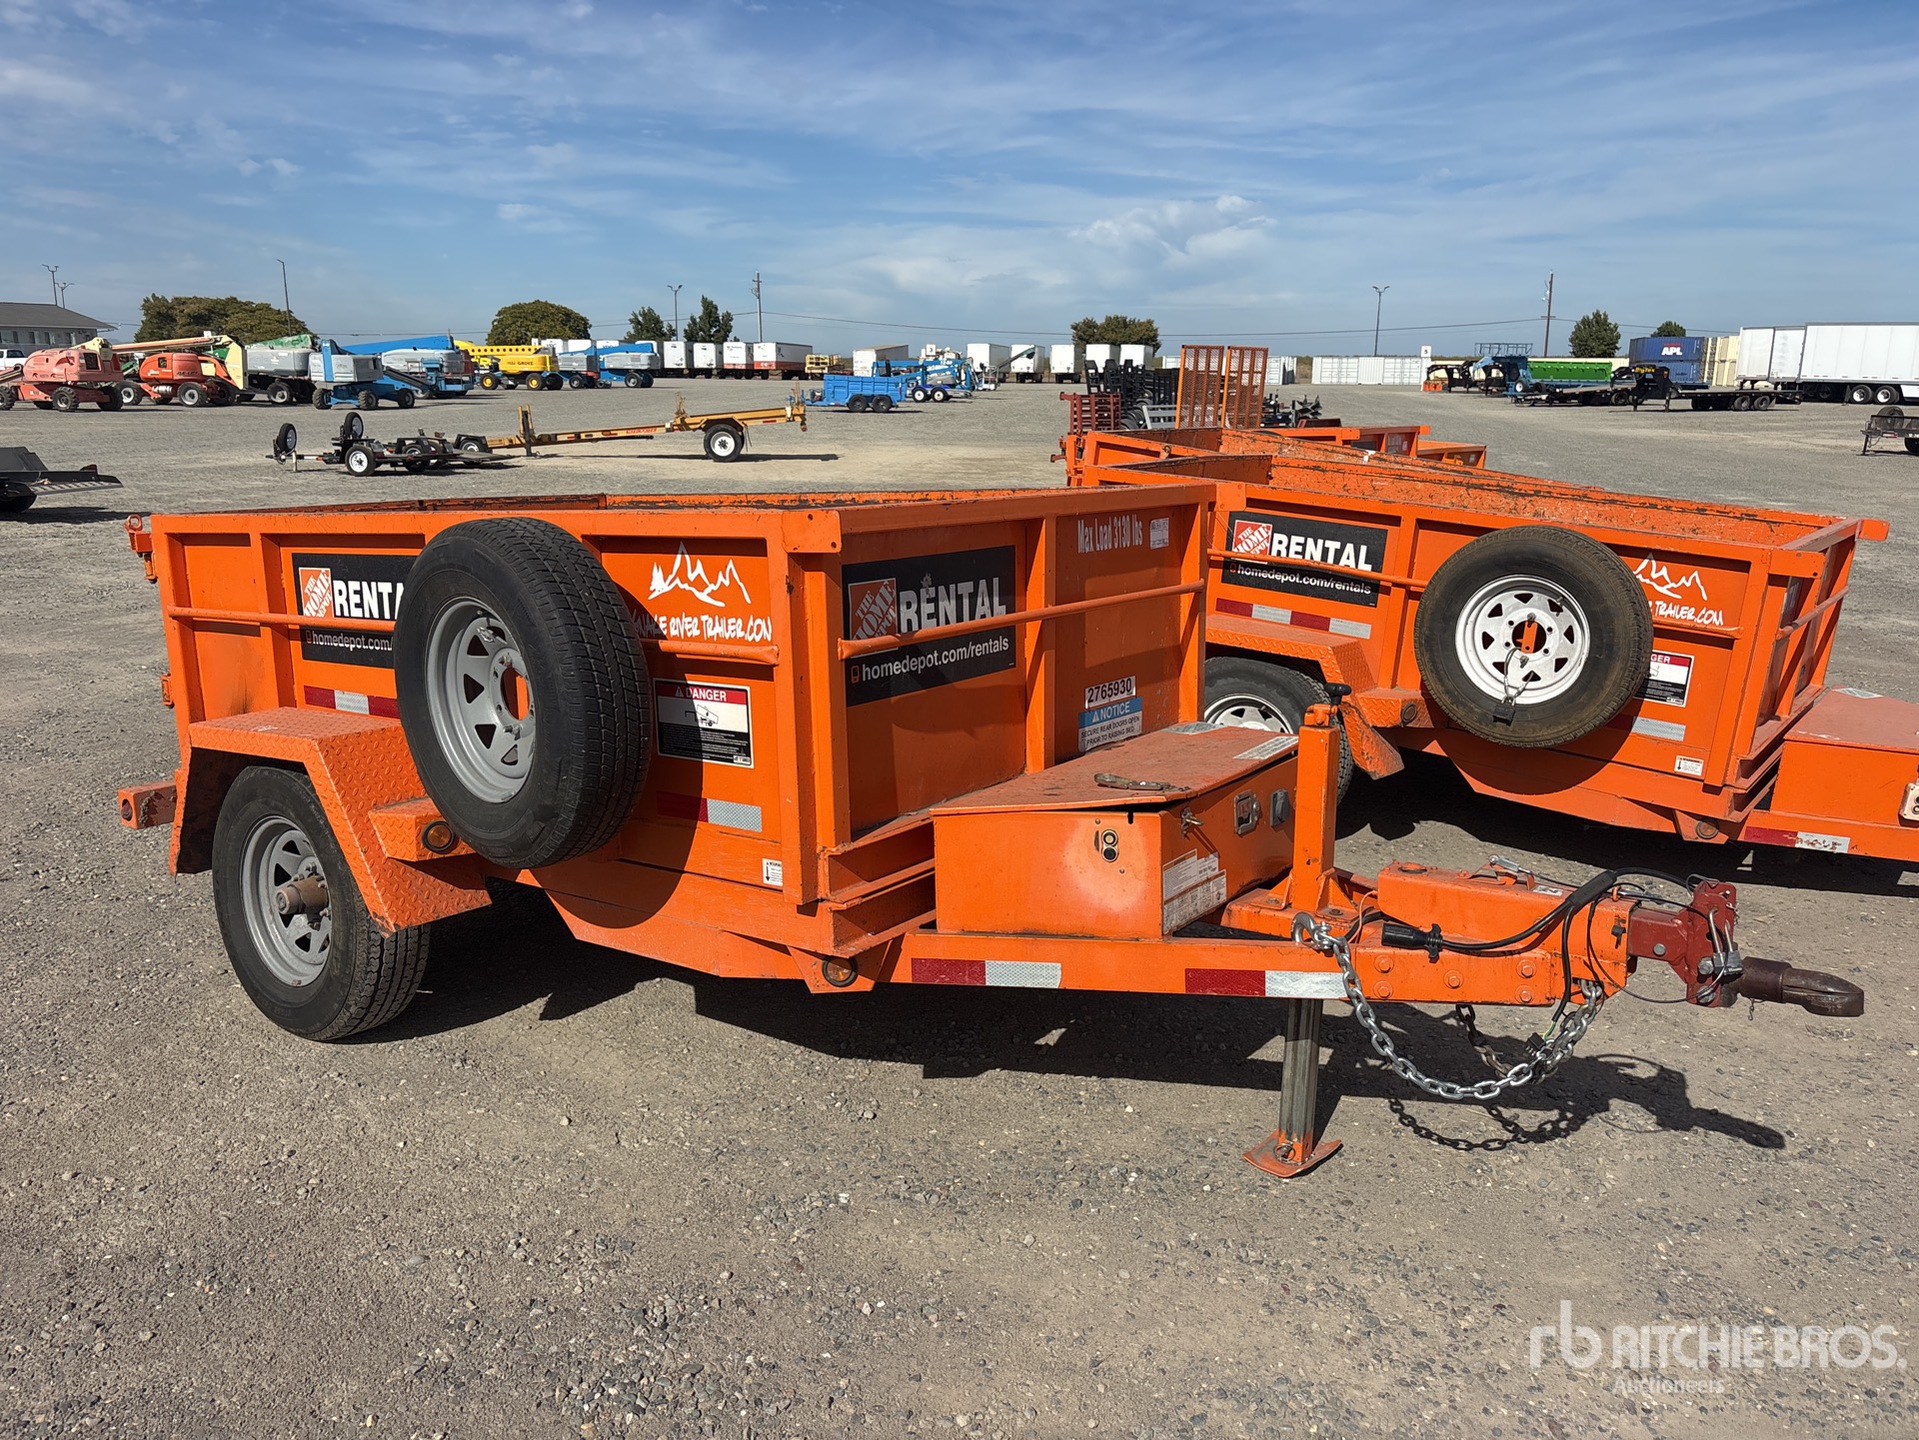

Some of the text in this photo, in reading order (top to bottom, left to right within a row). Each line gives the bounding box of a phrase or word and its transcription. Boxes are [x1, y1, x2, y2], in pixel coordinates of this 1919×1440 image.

[1661, 346, 1683, 356] APL
[1078, 519, 1094, 553] Max
[1095, 516, 1112, 551] Load
[1132, 513, 1143, 546] lbs
[1238, 526, 1254, 541] THE
[1271, 533, 1372, 571] RENTAL
[304, 574, 317, 596] THE
[1237, 563, 1372, 595] homedepot.com/rentals
[855, 590, 874, 620] THE
[899, 577, 1007, 633] RENTAL
[1655, 600, 1724, 626] TRAILER.COM
[670, 612, 701, 639] RIVER
[862, 635, 1009, 682] homedepot.com/rentals
[686, 687, 727, 702] DANGER
[1088, 677, 1132, 704] 2765930
[1100, 701, 1131, 720] NOTICE
[1086, 725, 1135, 746] PRIOR TO RAISING BED
[1100, 722, 1112, 733] REAR
[1112, 718, 1128, 729] DOORS
[1128, 715, 1140, 725] OPEN
